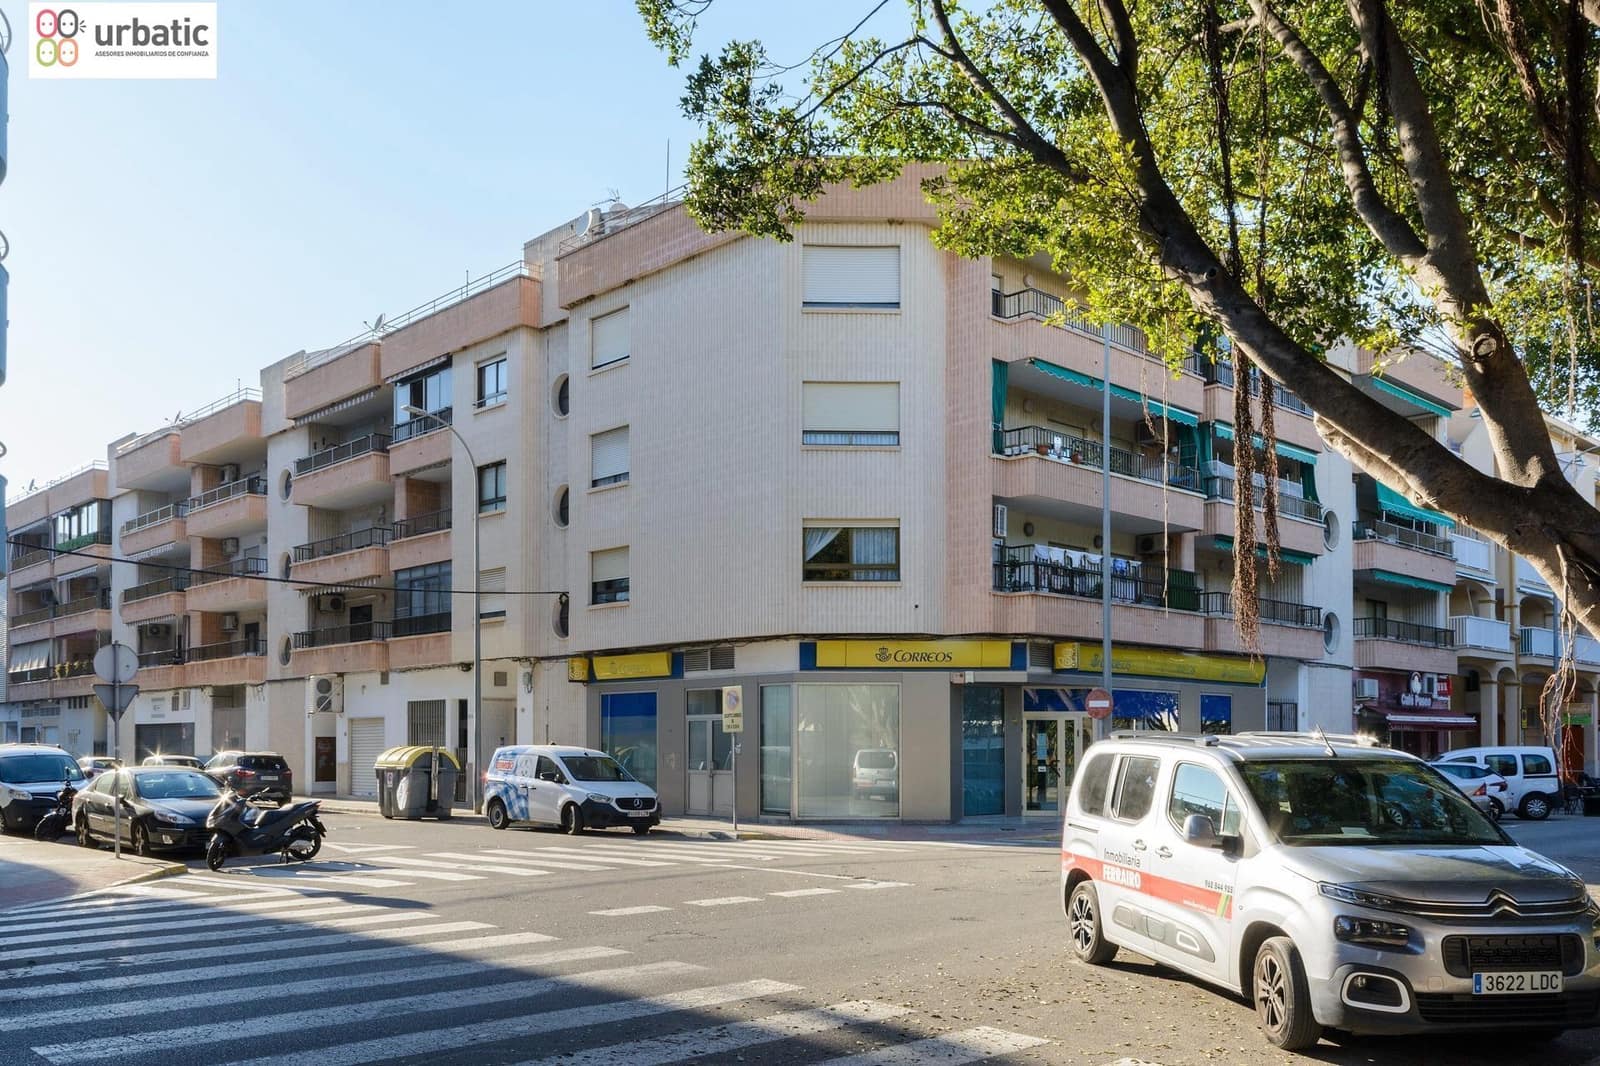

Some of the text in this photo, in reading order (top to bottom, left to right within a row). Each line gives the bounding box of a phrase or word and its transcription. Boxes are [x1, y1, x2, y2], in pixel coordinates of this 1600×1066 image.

[894, 649, 953, 663] CORREOS
[1104, 848, 1140, 868] Inmobiliaria
[1486, 974, 1559, 991] 3622 LDC
